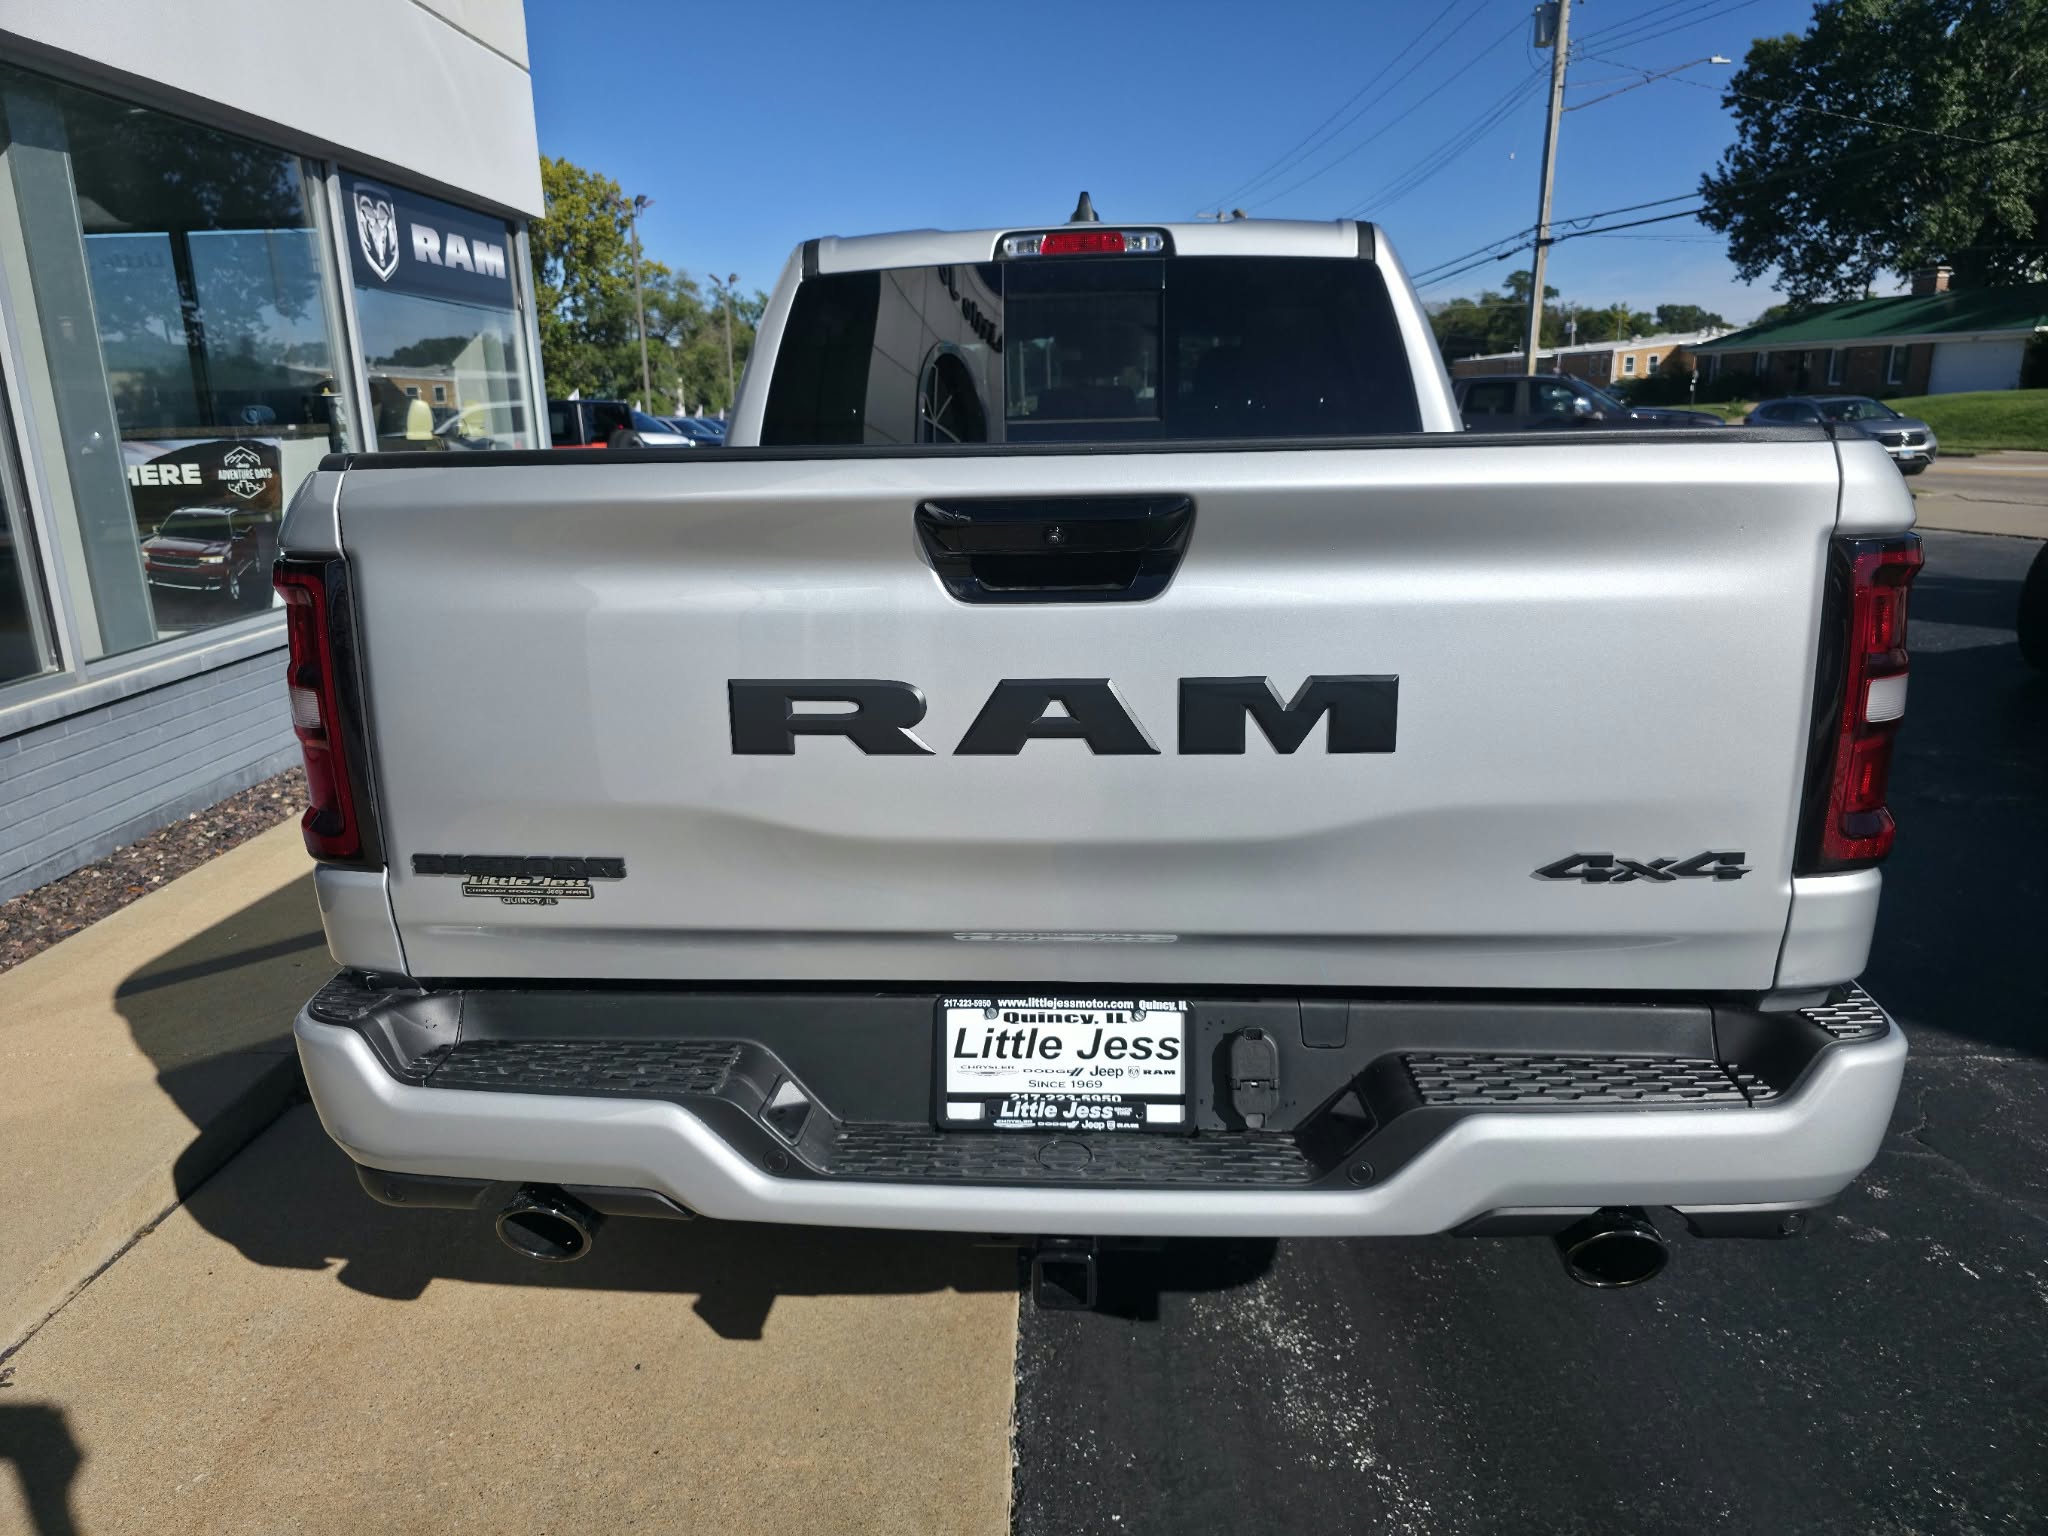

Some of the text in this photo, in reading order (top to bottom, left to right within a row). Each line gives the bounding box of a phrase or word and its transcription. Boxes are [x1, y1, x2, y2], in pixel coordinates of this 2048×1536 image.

[410, 222, 507, 279] RAM
[218, 467, 273, 481] ADVENTURE DAYS
[728, 674, 1399, 756] RAM
[1529, 849, 1753, 885] 4x4
[469, 875, 530, 887] Little
[502, 896, 556, 906] QUINCY, IL
[943, 998, 992, 1008] 217-223-5950
[997, 996, 1135, 1010] www.littlejessmotor.com
[1178, 1000, 1188, 1011] IL
[1003, 1011, 1128, 1025] Quincy, IL
[953, 1027, 1181, 1060] Little Jess
[1023, 1067, 1078, 1075] DODGE
[1089, 1065, 1124, 1078] Jeep
[1028, 1079, 1103, 1088] SINCE 1969
[1000, 1100, 1058, 1118] Little
[1063, 1101, 1114, 1119] Jess
[1081, 1120, 1105, 1130] Jeep
